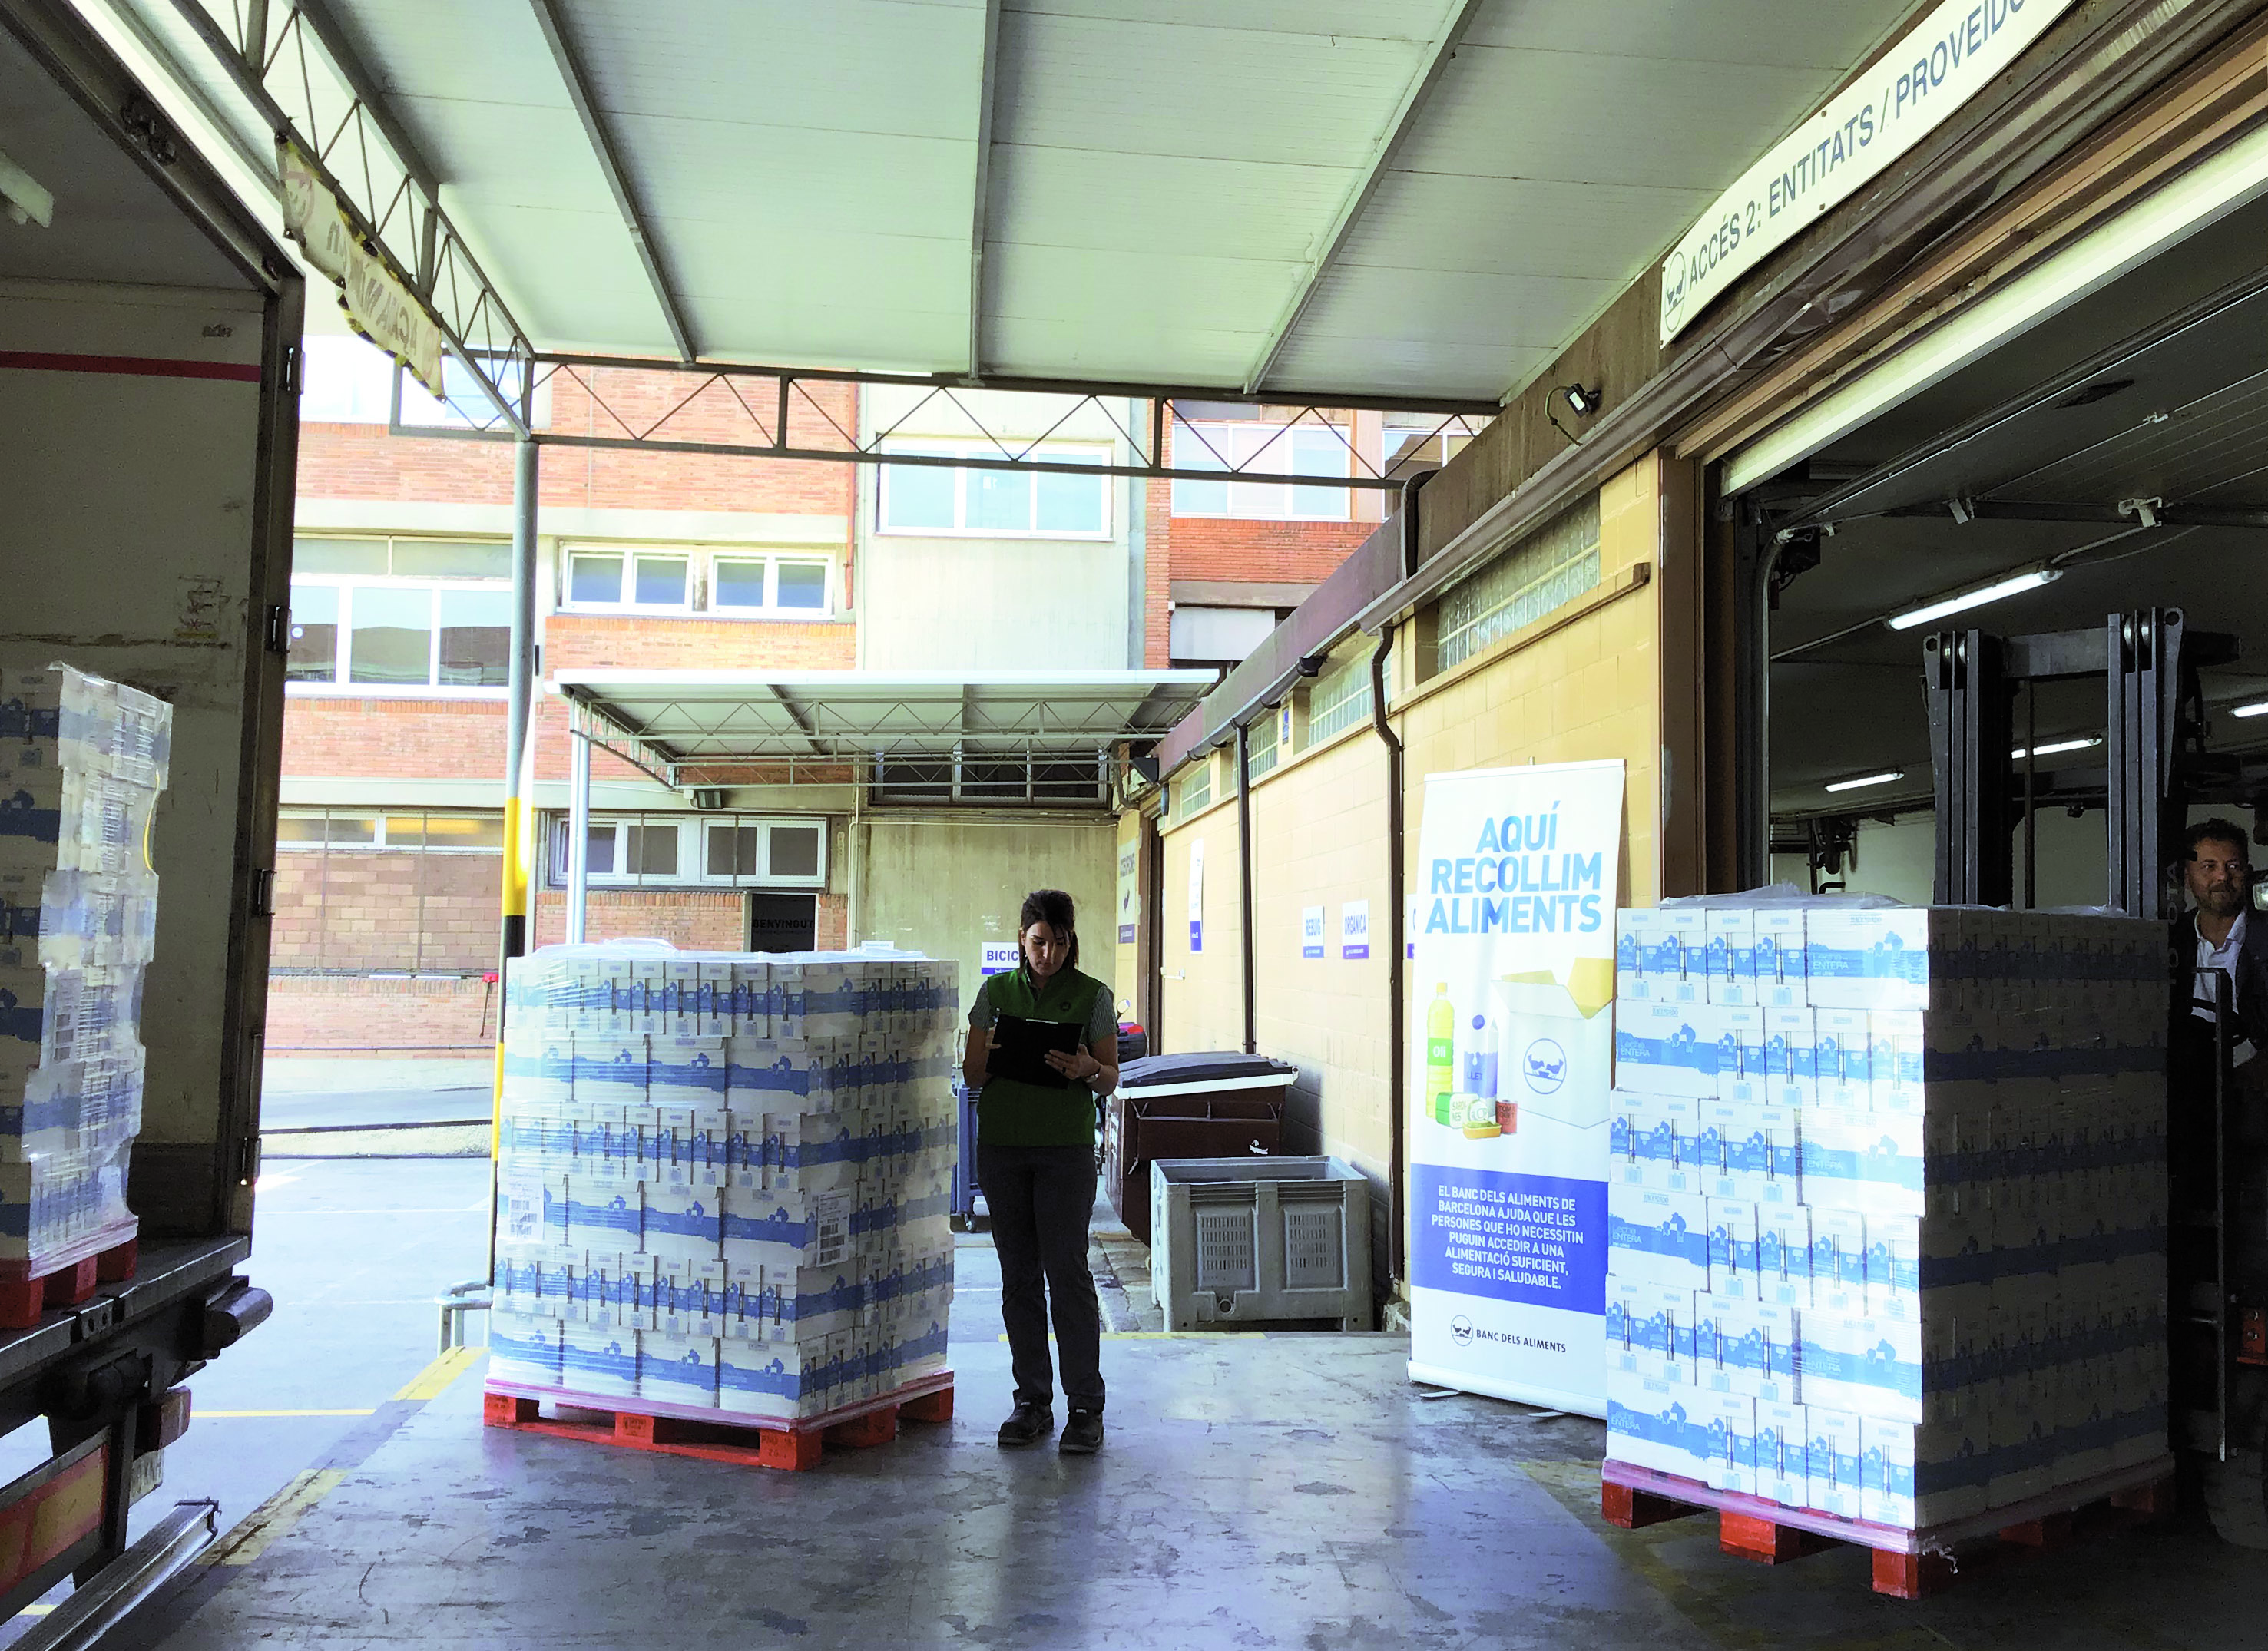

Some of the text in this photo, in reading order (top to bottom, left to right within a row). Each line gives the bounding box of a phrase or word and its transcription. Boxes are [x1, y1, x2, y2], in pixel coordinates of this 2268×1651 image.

[1689, 213, 1740, 291] ACCÉS
[1746, 200, 1761, 238] 2:
[1769, 104, 1874, 220] ENTITATS
[1879, 87, 1889, 133] /
[1475, 800, 1561, 853] AQUÍ
[1432, 852, 1601, 894] RECOLLIM
[1425, 894, 1601, 934] ALIMENTS
[2166, 860, 2179, 985] OOTA
[986, 950, 1019, 961] BICIC
[1813, 961, 1849, 970] ENTERA
[1432, 1045, 1446, 1057] Oli
[1621, 1048, 1651, 1057] ENTERA
[1467, 1071, 1483, 1080] LLET
[1438, 1185, 1575, 1211] EL BANC DELS ALIMENTS DE
[1438, 1200, 1575, 1227] BARCELONA AJUDA QUE LES
[1432, 1214, 1584, 1244] PERSONES QUE HO NECESSITIN
[1613, 1232, 1642, 1244] ENTERA
[1449, 1231, 1564, 1258] PUGUIN ACCEDIR A UNA
[1445, 1246, 1569, 1276] ALIMENTACIÓ SUFICIENT,
[1452, 1262, 1561, 1289] SEGURA I SALUDABLE.
[1476, 1329, 1566, 1353] BANC DELS ALIMENTS
